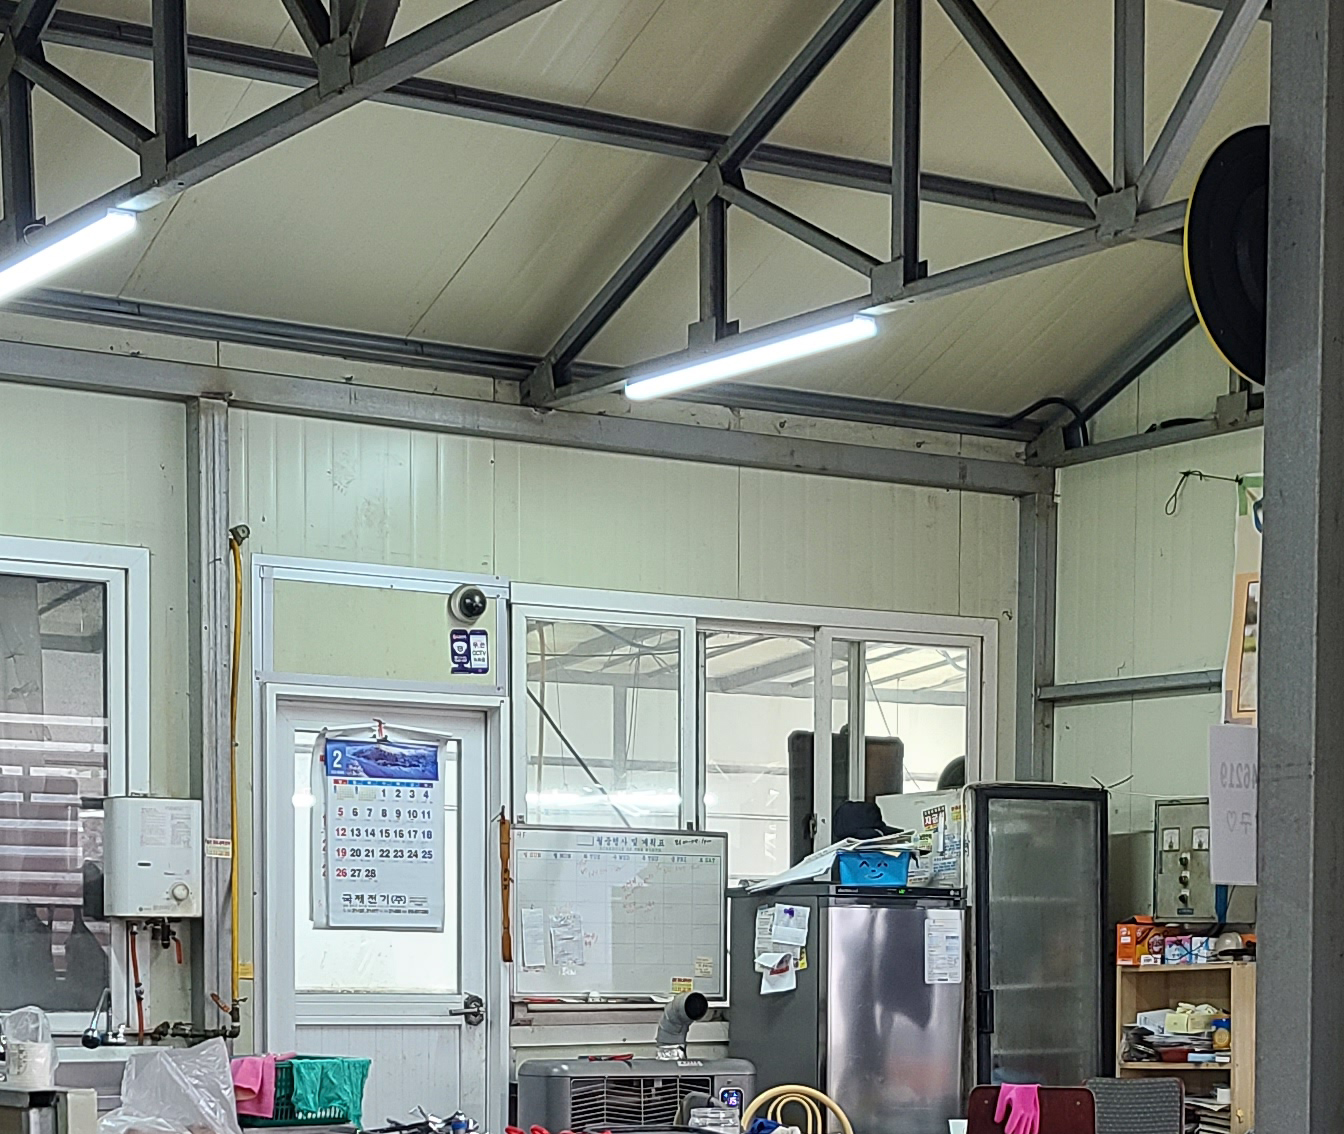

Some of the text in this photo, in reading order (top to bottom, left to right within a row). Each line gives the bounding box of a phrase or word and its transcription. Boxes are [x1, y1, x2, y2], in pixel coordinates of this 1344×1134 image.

[333, 750, 342, 768] 2
[381, 788, 429, 799] 1 2 3 4
[338, 807, 431, 819] 5 6 7 8 9 10 11
[336, 827, 432, 839] 12 13 14 15 16 17 18
[336, 848, 433, 859] 19 20 21 22 23 24 25
[336, 869, 376, 878] 26 27 28
